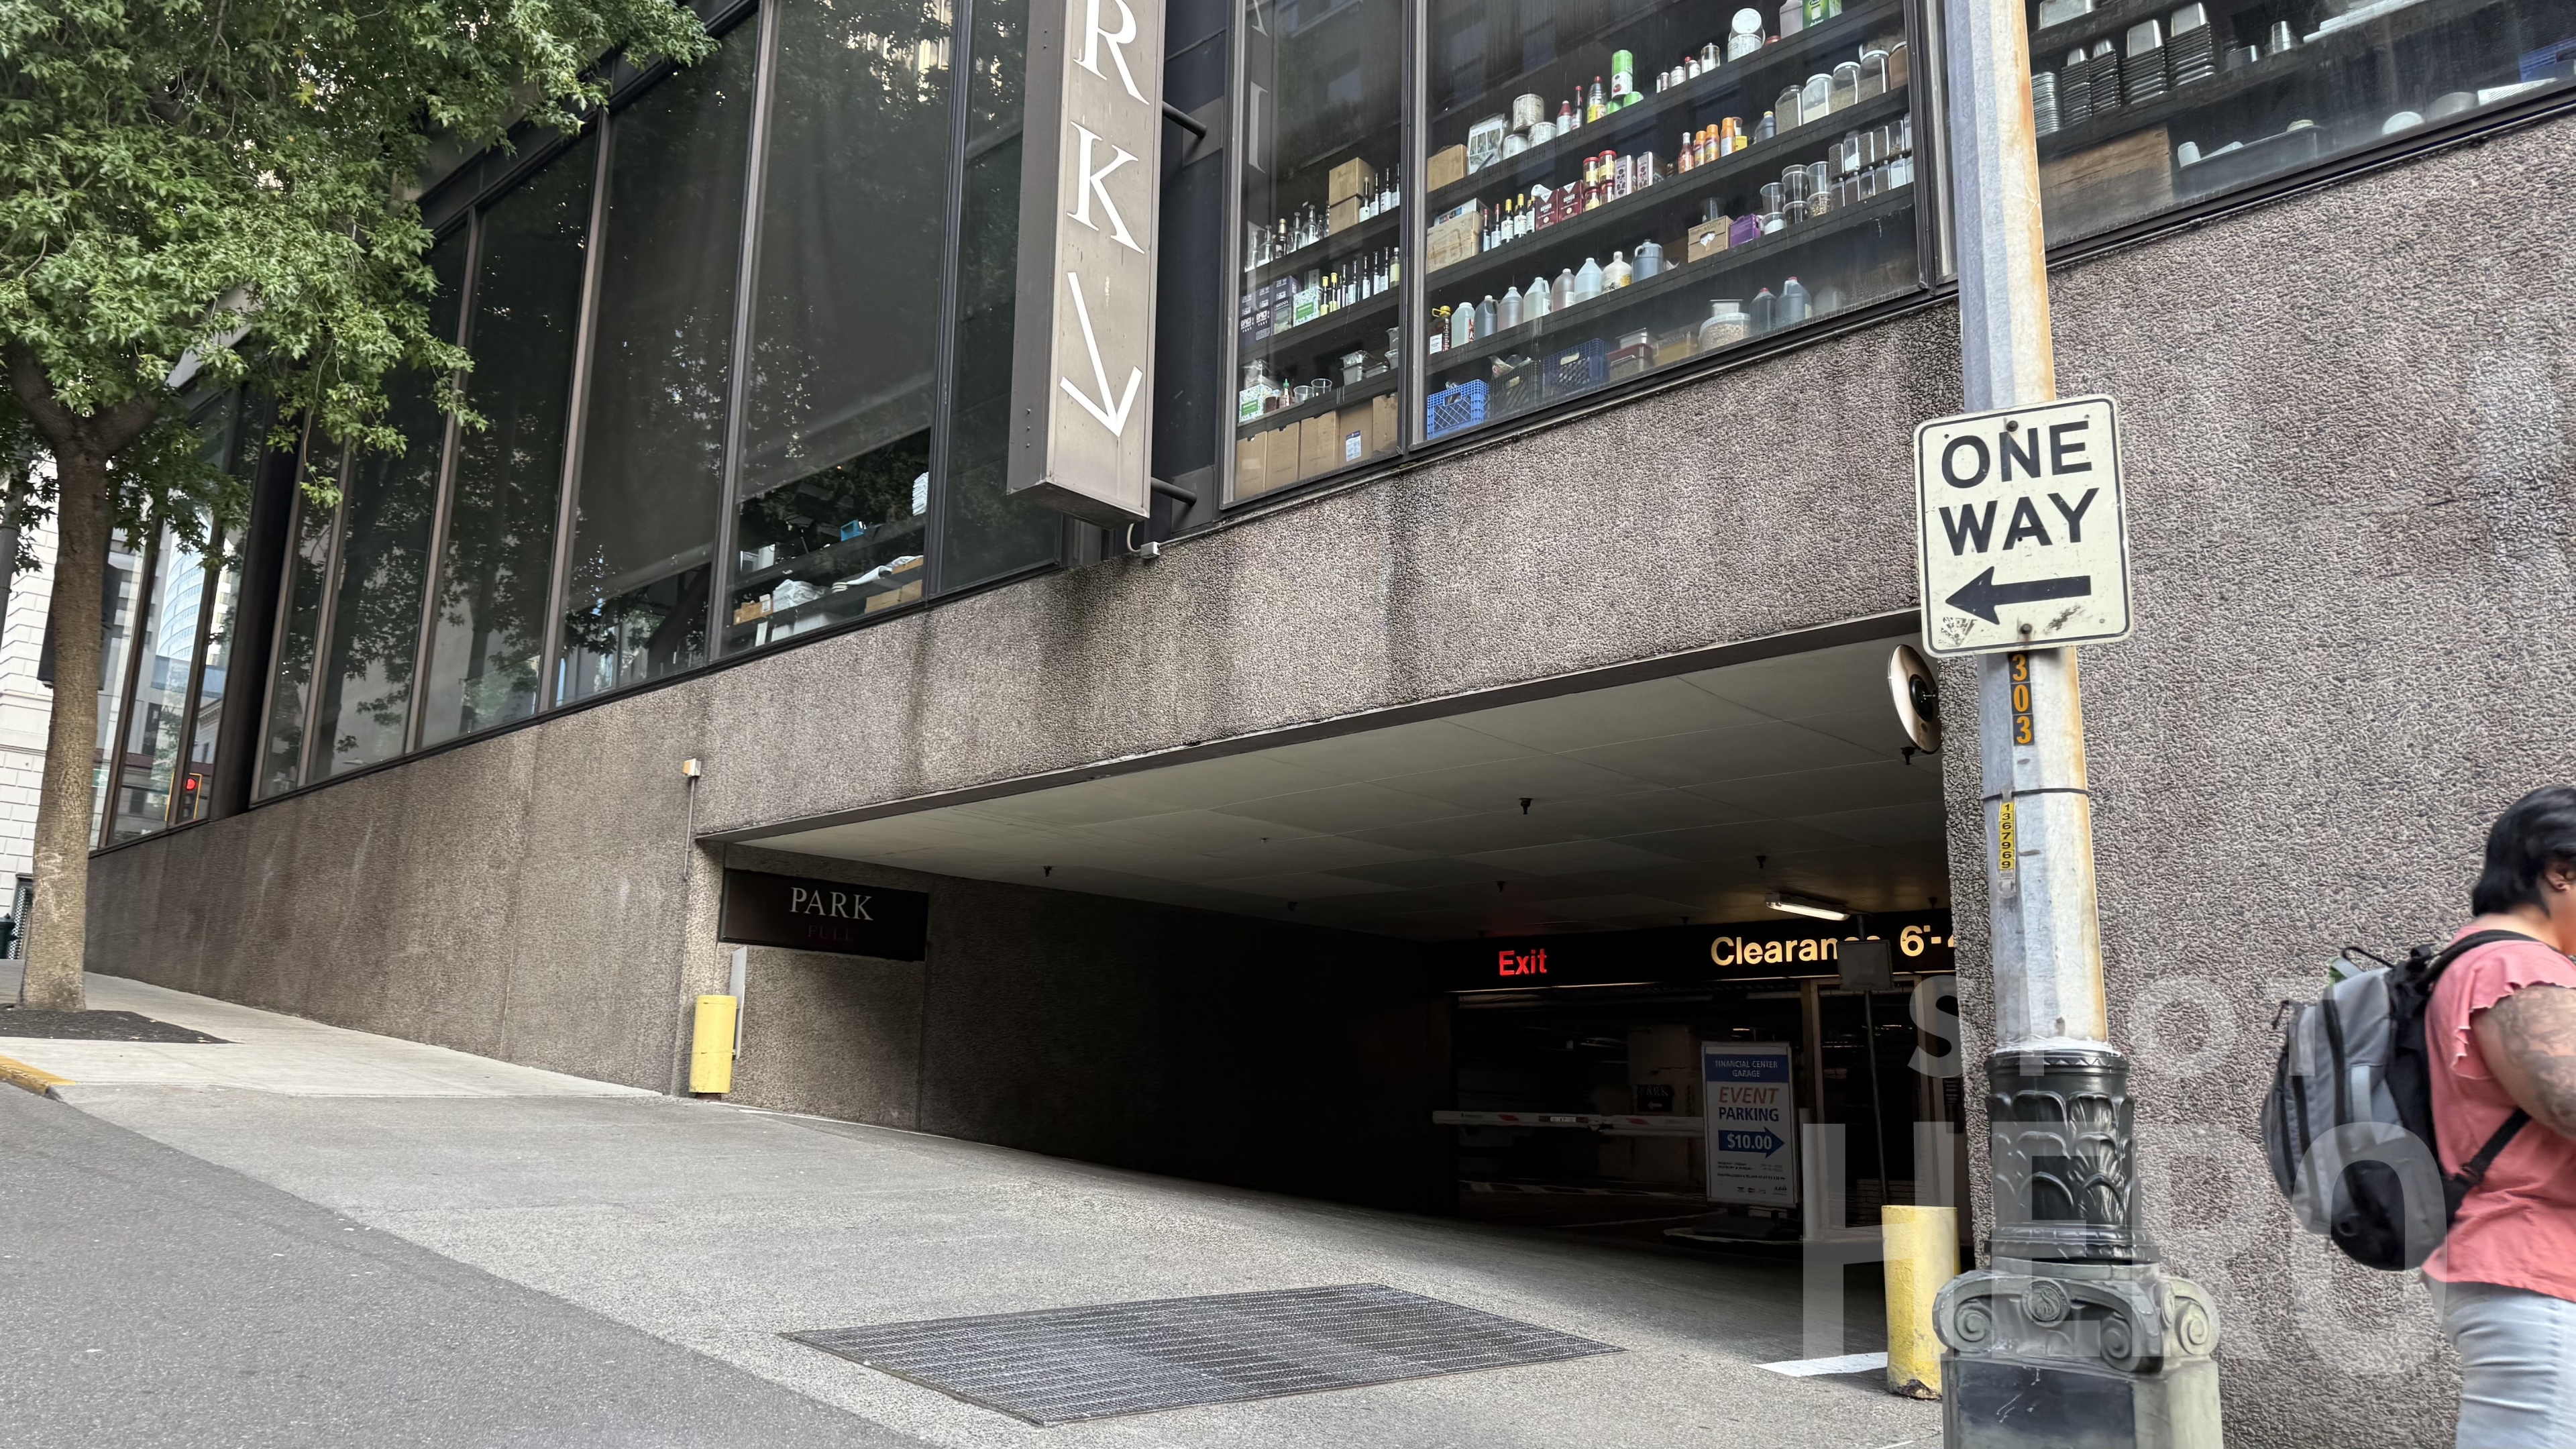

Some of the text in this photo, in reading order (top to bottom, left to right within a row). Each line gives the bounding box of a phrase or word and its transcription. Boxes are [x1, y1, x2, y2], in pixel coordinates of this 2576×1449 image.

[1941, 421, 2092, 488] ONE
[1938, 488, 2100, 556] WAY
[2012, 653, 2032, 744] 303
[2001, 804, 2012, 869] 1367969
[789, 887, 874, 921] PARK
[1499, 949, 1547, 975] Exit
[1711, 935, 1880, 966] Clearan
[1732, 1069, 1760, 1077] GARAGE
[1719, 1086, 1779, 1104] EVENT
[1719, 1107, 1779, 1122] PARKING
[1727, 1132, 1772, 1150] $10.00
